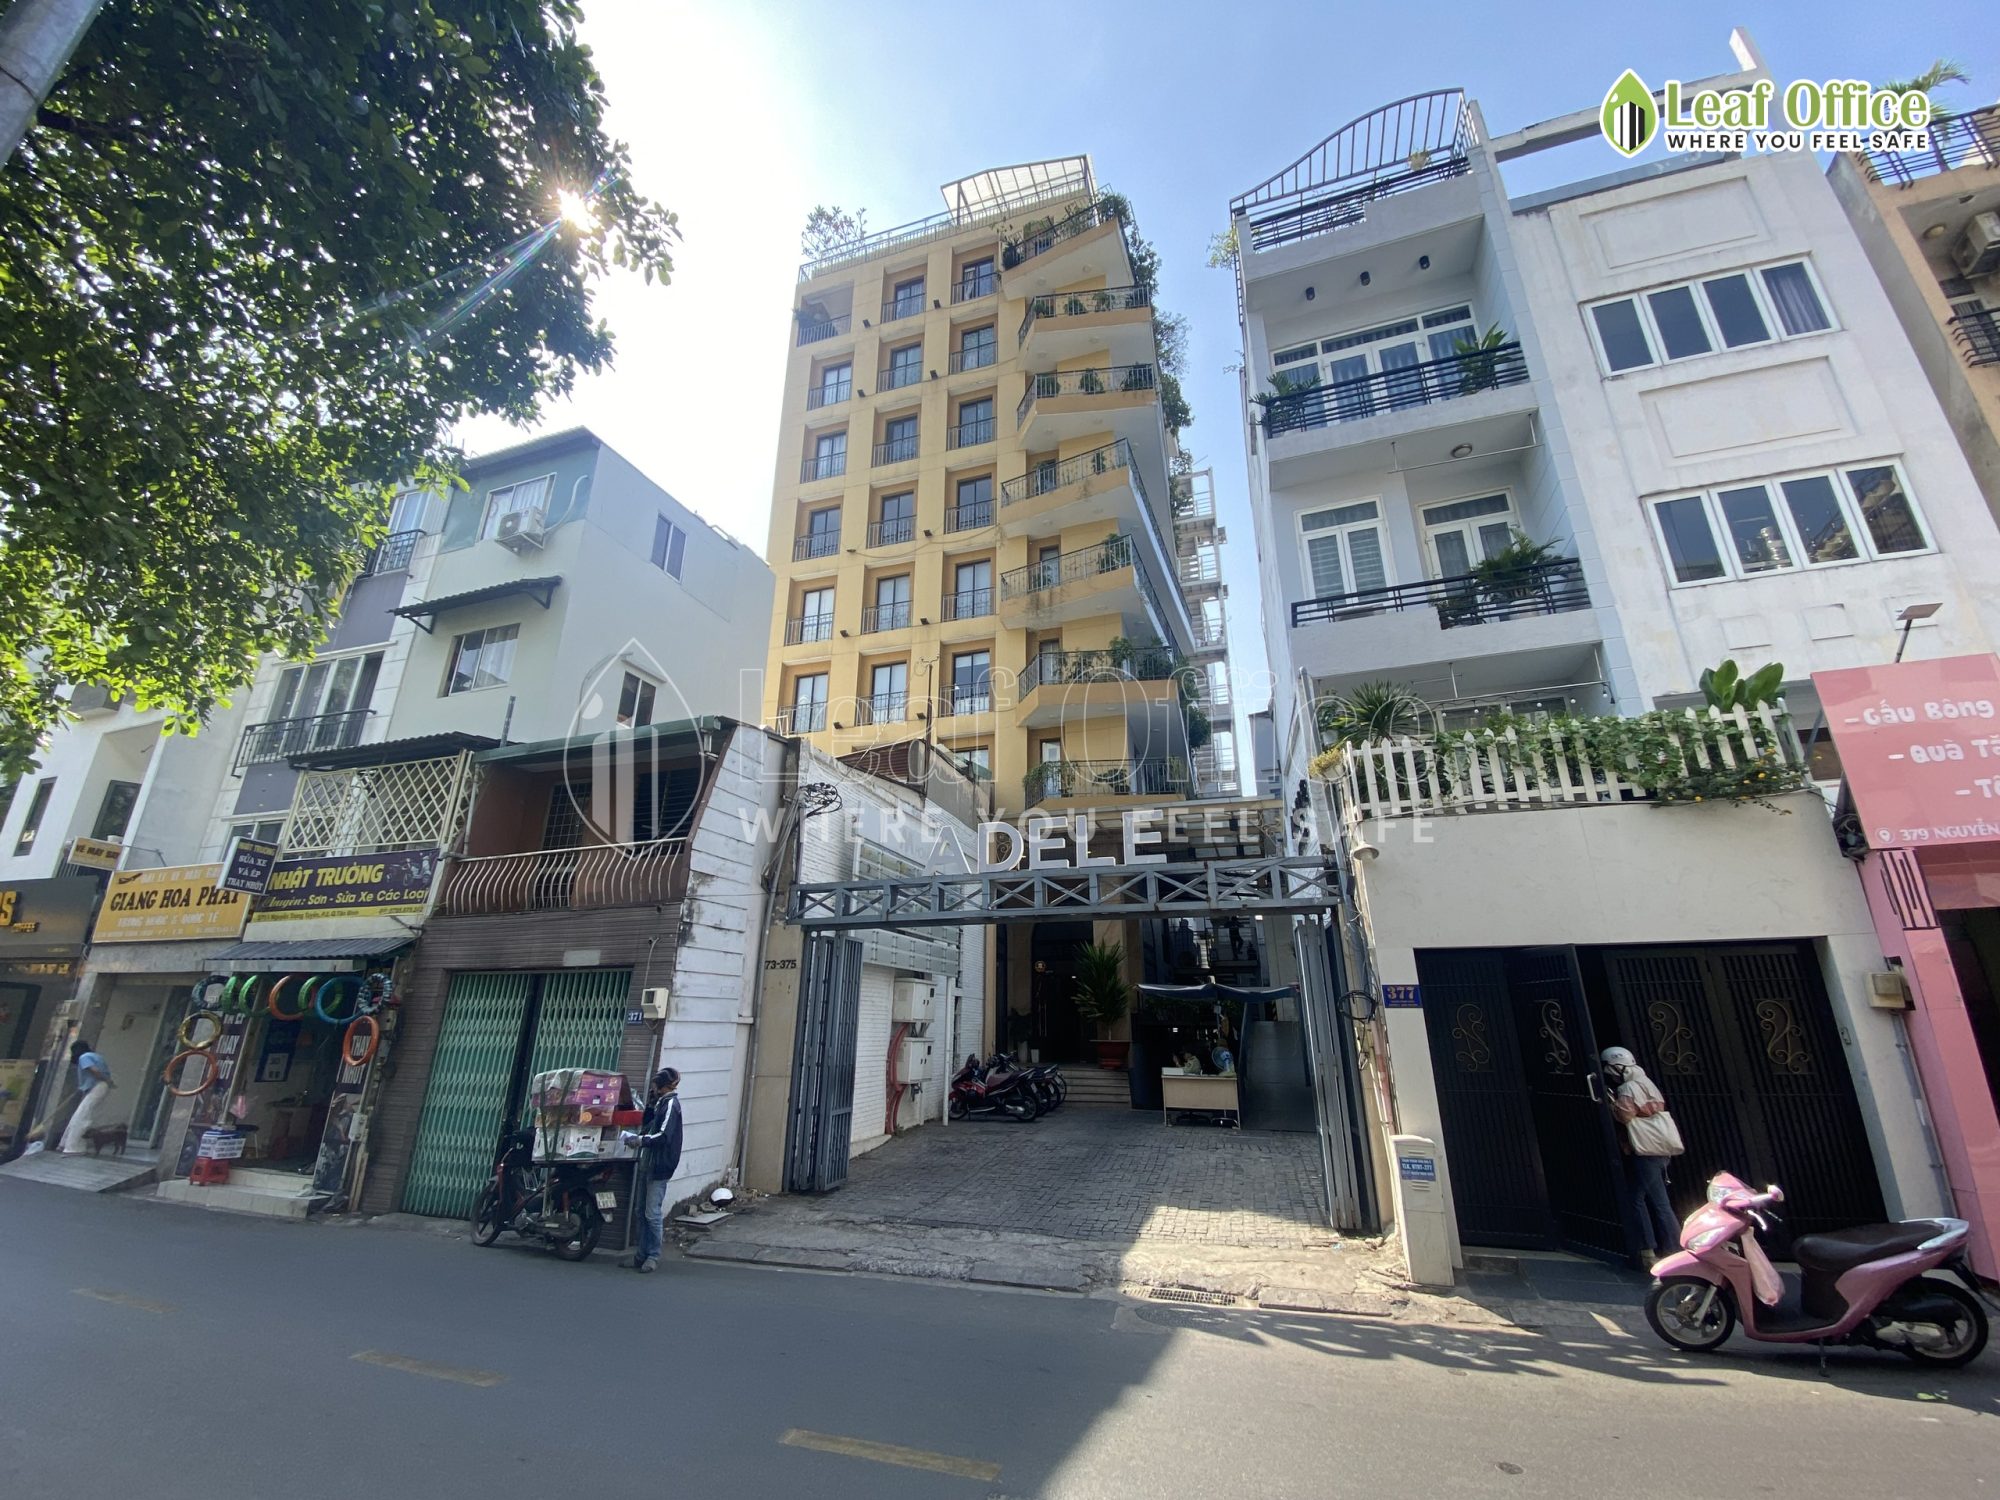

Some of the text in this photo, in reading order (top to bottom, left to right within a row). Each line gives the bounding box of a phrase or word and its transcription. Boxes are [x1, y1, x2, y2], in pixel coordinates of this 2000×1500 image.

[1923, 698, 1995, 720] Bông
[921, 807, 1169, 878] ADELE
[1899, 827, 1930, 842] 379
[268, 866, 313, 893] NHẬT
[109, 890, 159, 912] GIANG
[358, 891, 374, 903] Xe
[376, 888, 401, 901] Các
[1387, 986, 1415, 1000] 377
